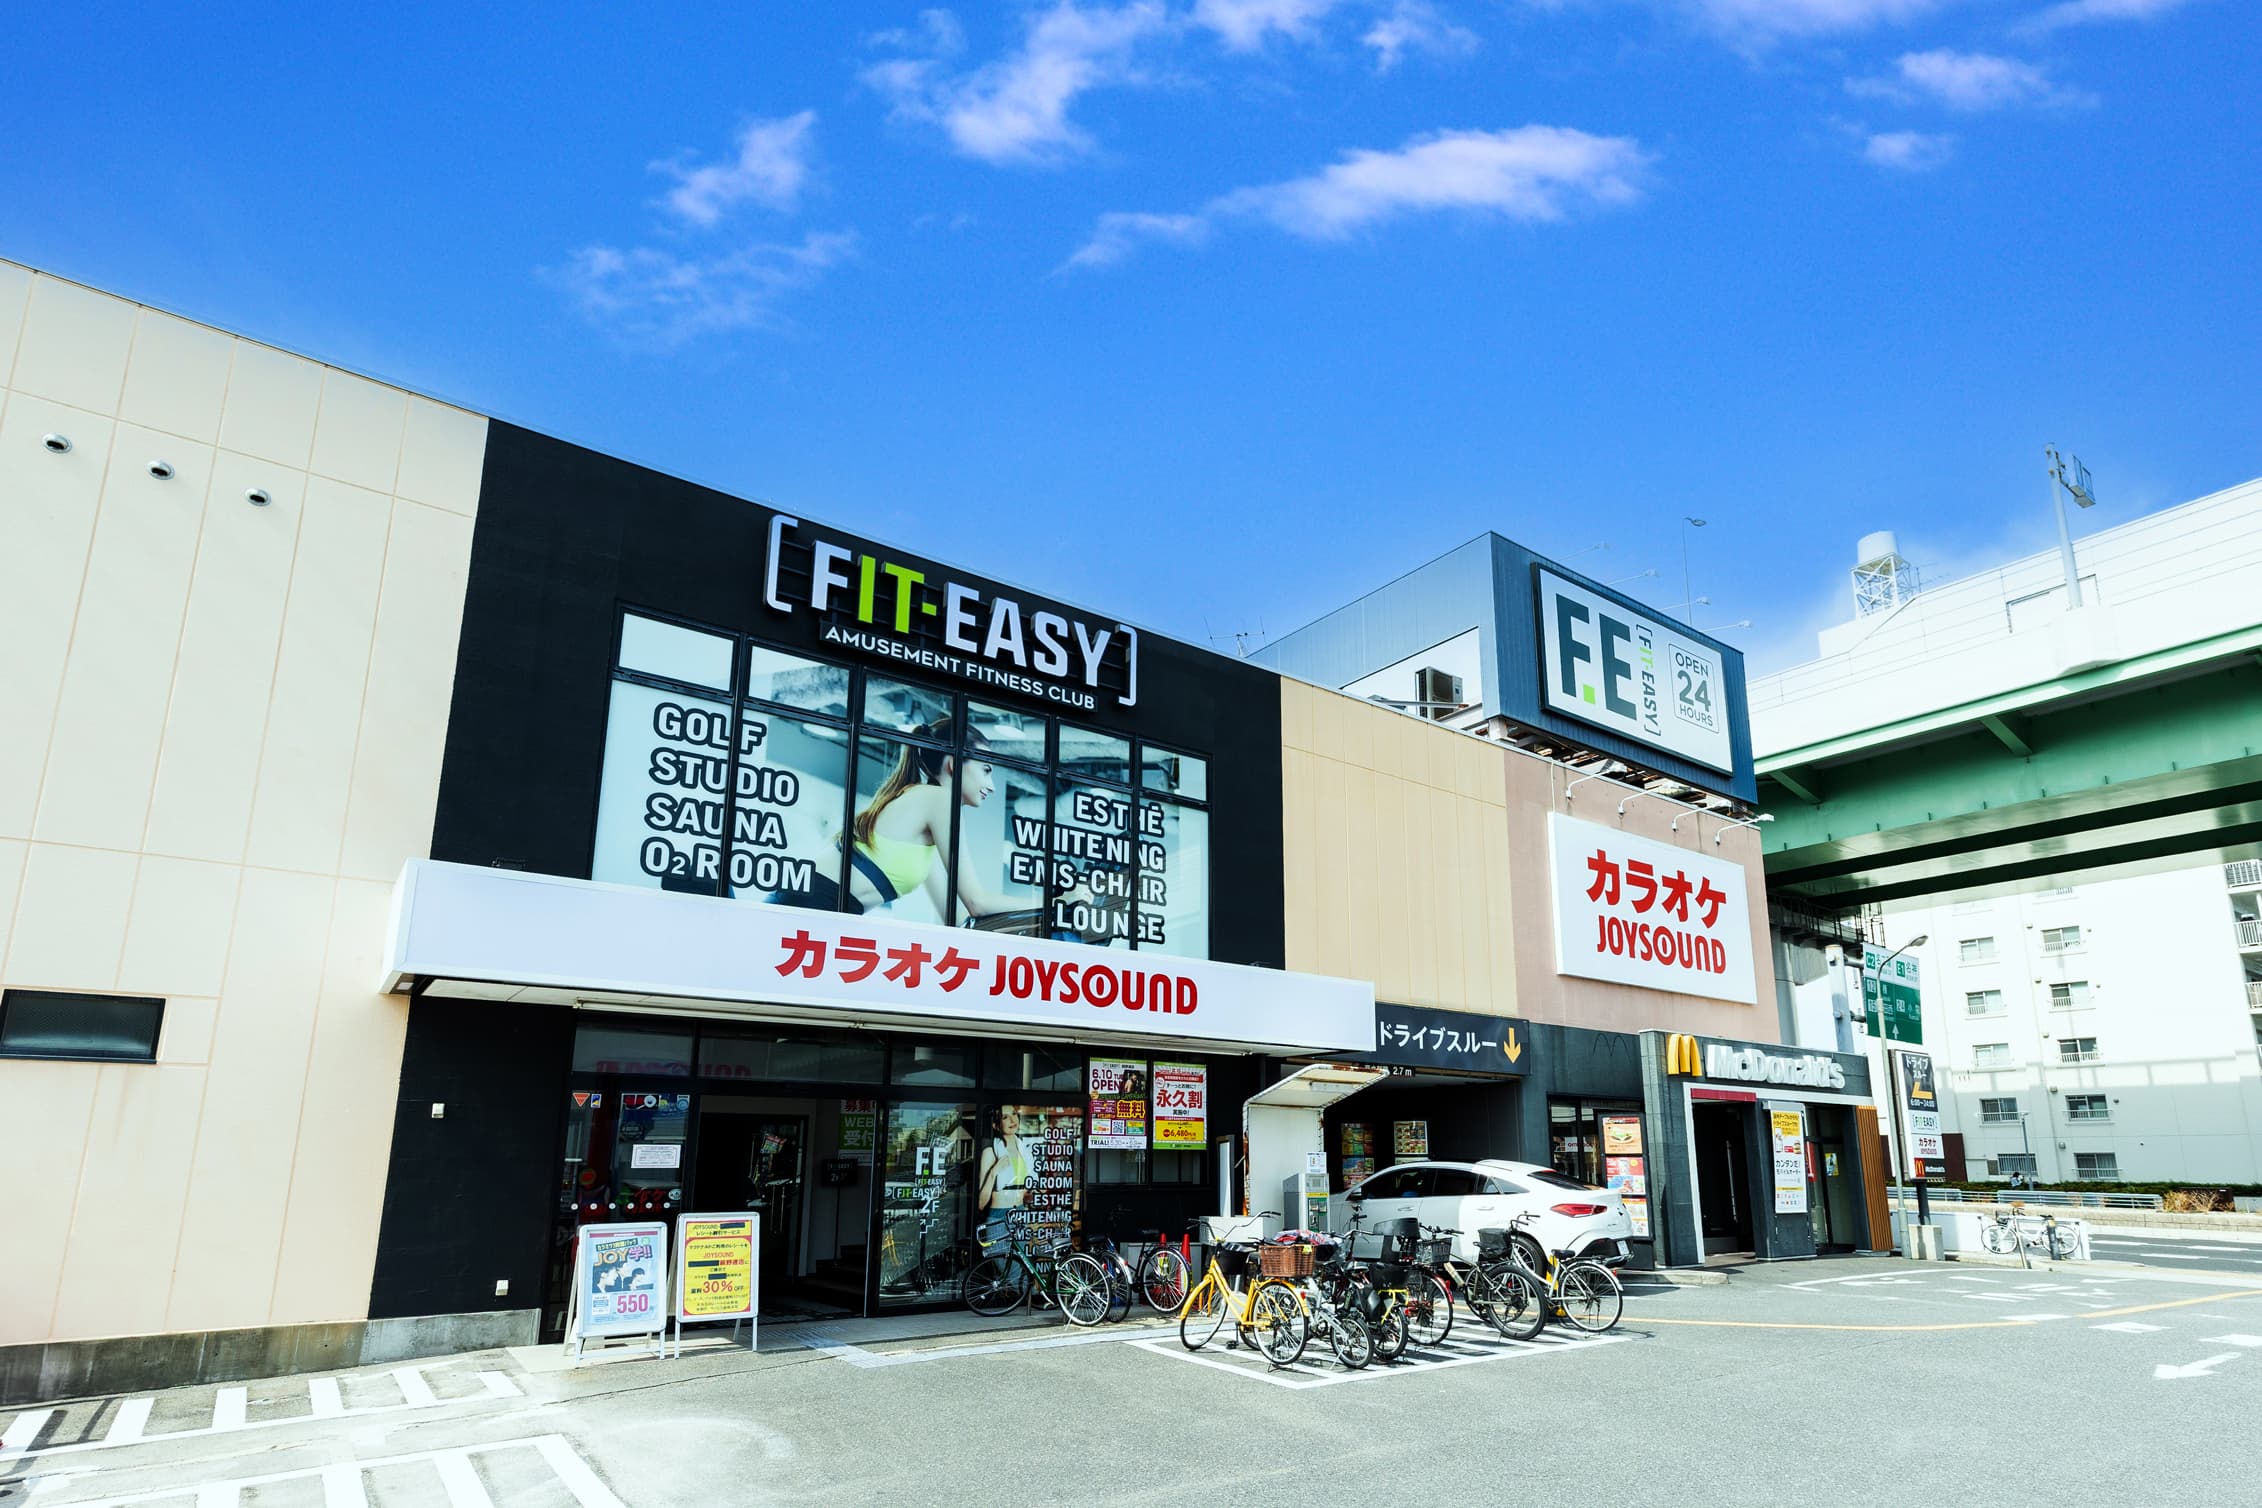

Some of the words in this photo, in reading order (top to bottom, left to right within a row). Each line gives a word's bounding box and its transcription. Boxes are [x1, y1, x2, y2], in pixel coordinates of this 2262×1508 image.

[825, 625, 961, 674] AMUSEMENT
[966, 663, 1044, 697] FITNESS
[1048, 686, 1096, 711] CLUB
[1675, 652, 1709, 678] OPEN
[1677, 669, 1712, 713] 24
[656, 704, 764, 752] GOLF
[1679, 705, 1714, 727] HOURS
[653, 750, 796, 803] STUDIO
[649, 796, 784, 846] SAUNA
[695, 847, 812, 893] ROOM
[1585, 848, 1727, 929] カラオケ
[1056, 902, 1164, 941] LOUNGE
[1596, 914, 1727, 975] JOYSOUND
[775, 929, 980, 993] カラオケ
[989, 954, 1198, 1016] JOYSOUND
[1380, 1020, 1497, 1053] ドライブスルー
[1706, 1044, 1846, 1089] McDonald's
[1905, 1054, 1929, 1070] ドライブ
[1091, 1078, 1121, 1091] OPEN
[1117, 1099, 1146, 1119] 無料
[1156, 1088, 1203, 1110] 永久割
[1044, 1128, 1074, 1140] GOLF
[1919, 1137, 1937, 1147] カラオケ
[1033, 1144, 1073, 1156] STUDIO
[1034, 1160, 1073, 1172] SAUNA
[1039, 1176, 1073, 1189] ROOM
[920, 1198, 940, 1214] 2F
[702, 1280, 733, 1293] 30%
[617, 1293, 649, 1314] 550
